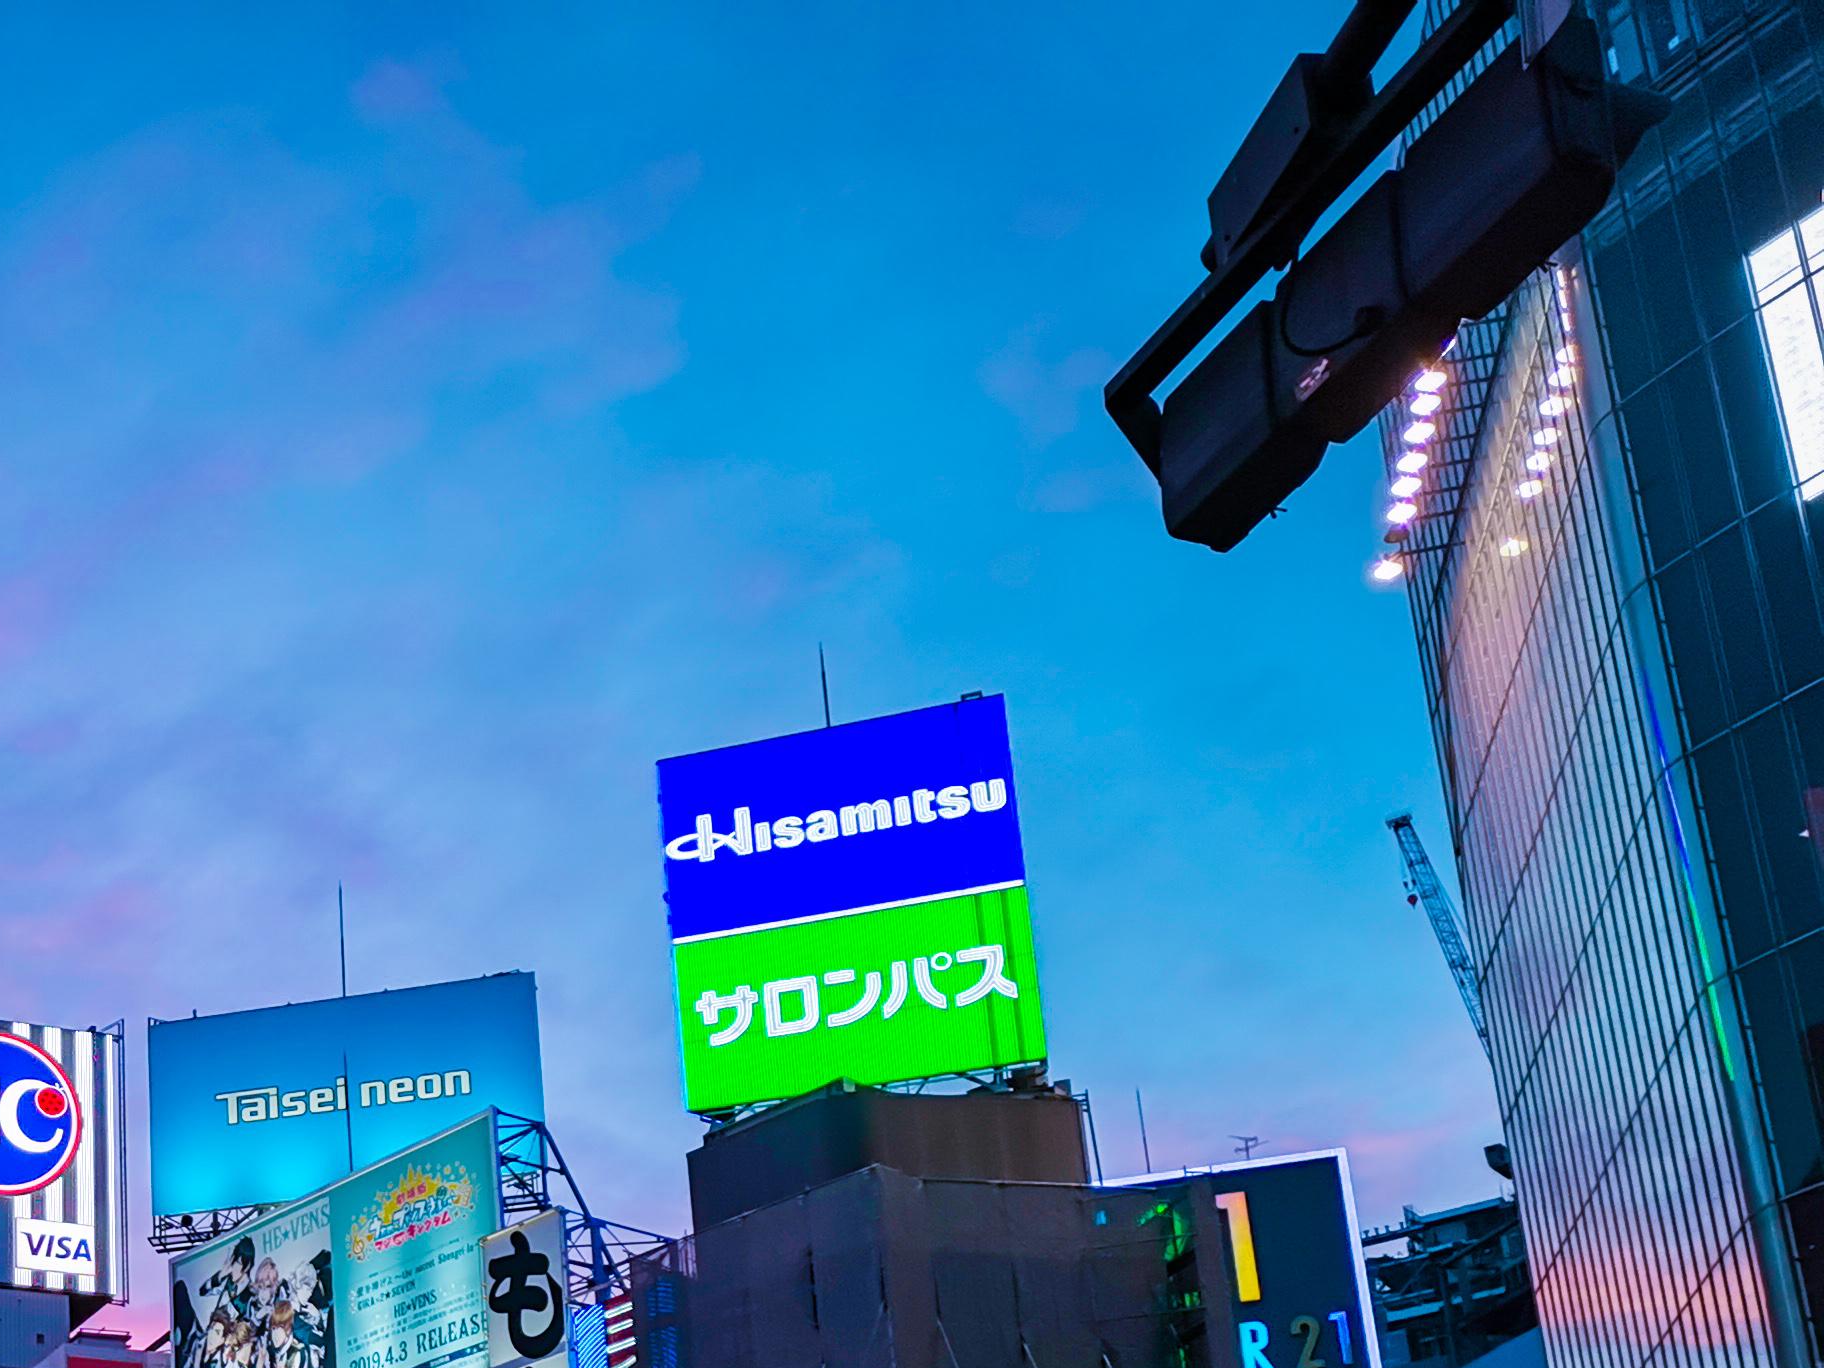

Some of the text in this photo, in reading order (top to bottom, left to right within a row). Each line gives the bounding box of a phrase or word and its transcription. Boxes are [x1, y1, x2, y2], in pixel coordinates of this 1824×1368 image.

[664, 777, 1007, 862] Hisamitsu
[695, 944, 1019, 1048] サロンパス
[216, 1068, 472, 1125] Taisei neon
[20, 1231, 92, 1262] VISA
